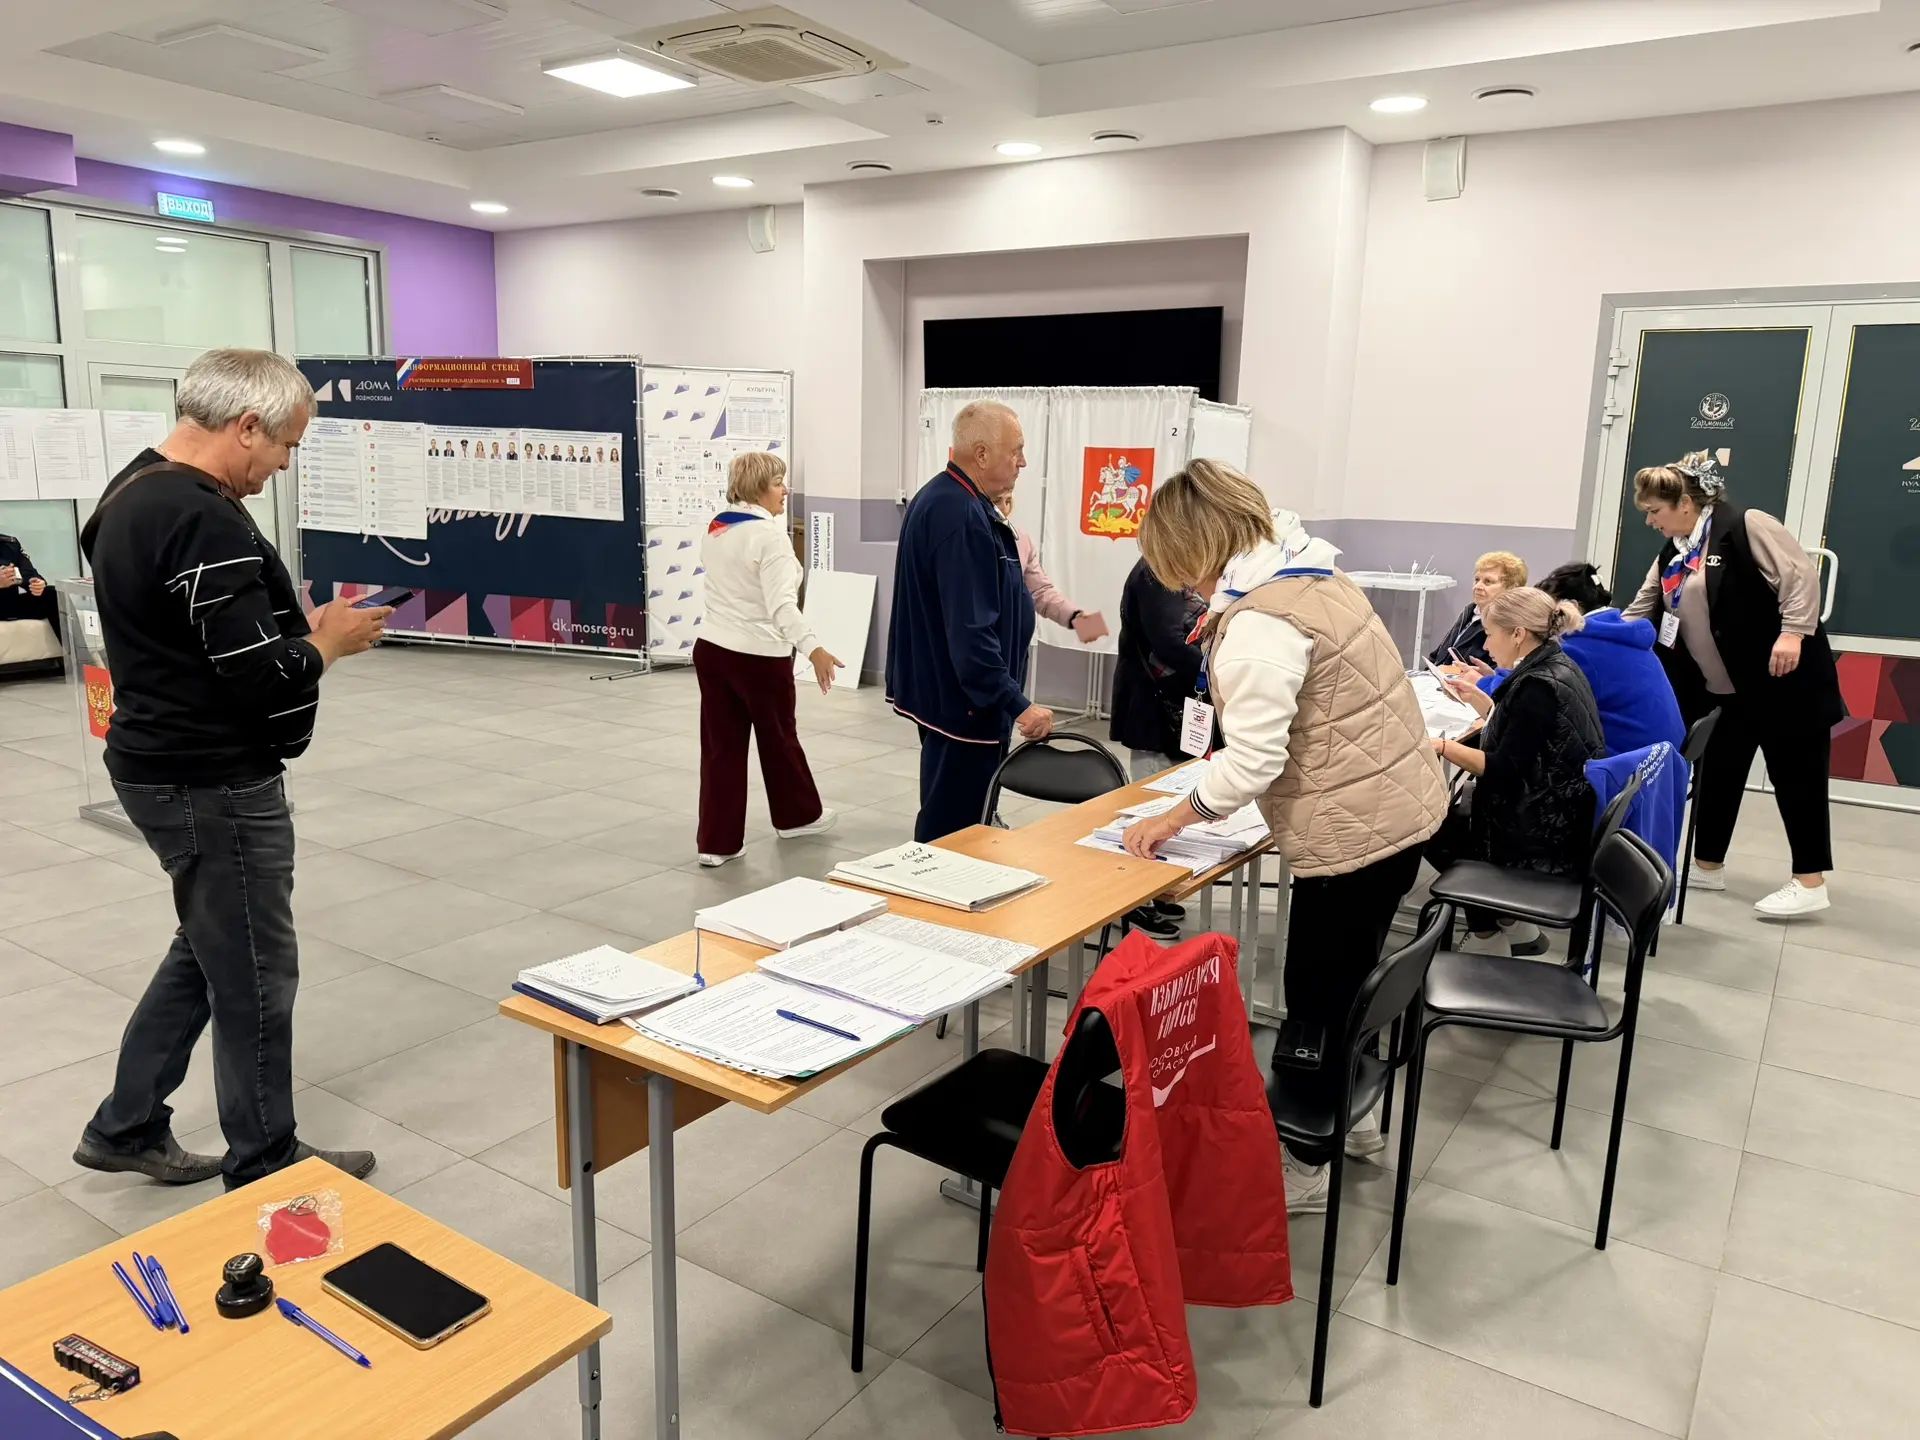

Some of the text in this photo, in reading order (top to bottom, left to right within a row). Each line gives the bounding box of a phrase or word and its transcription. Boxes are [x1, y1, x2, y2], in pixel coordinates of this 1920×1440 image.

[168, 199, 209, 216] ВЫХОД
[491, 363, 520, 372] СТЕНД
[356, 380, 391, 390] ДОМА
[552, 617, 634, 639] dk.mosreg.ru
